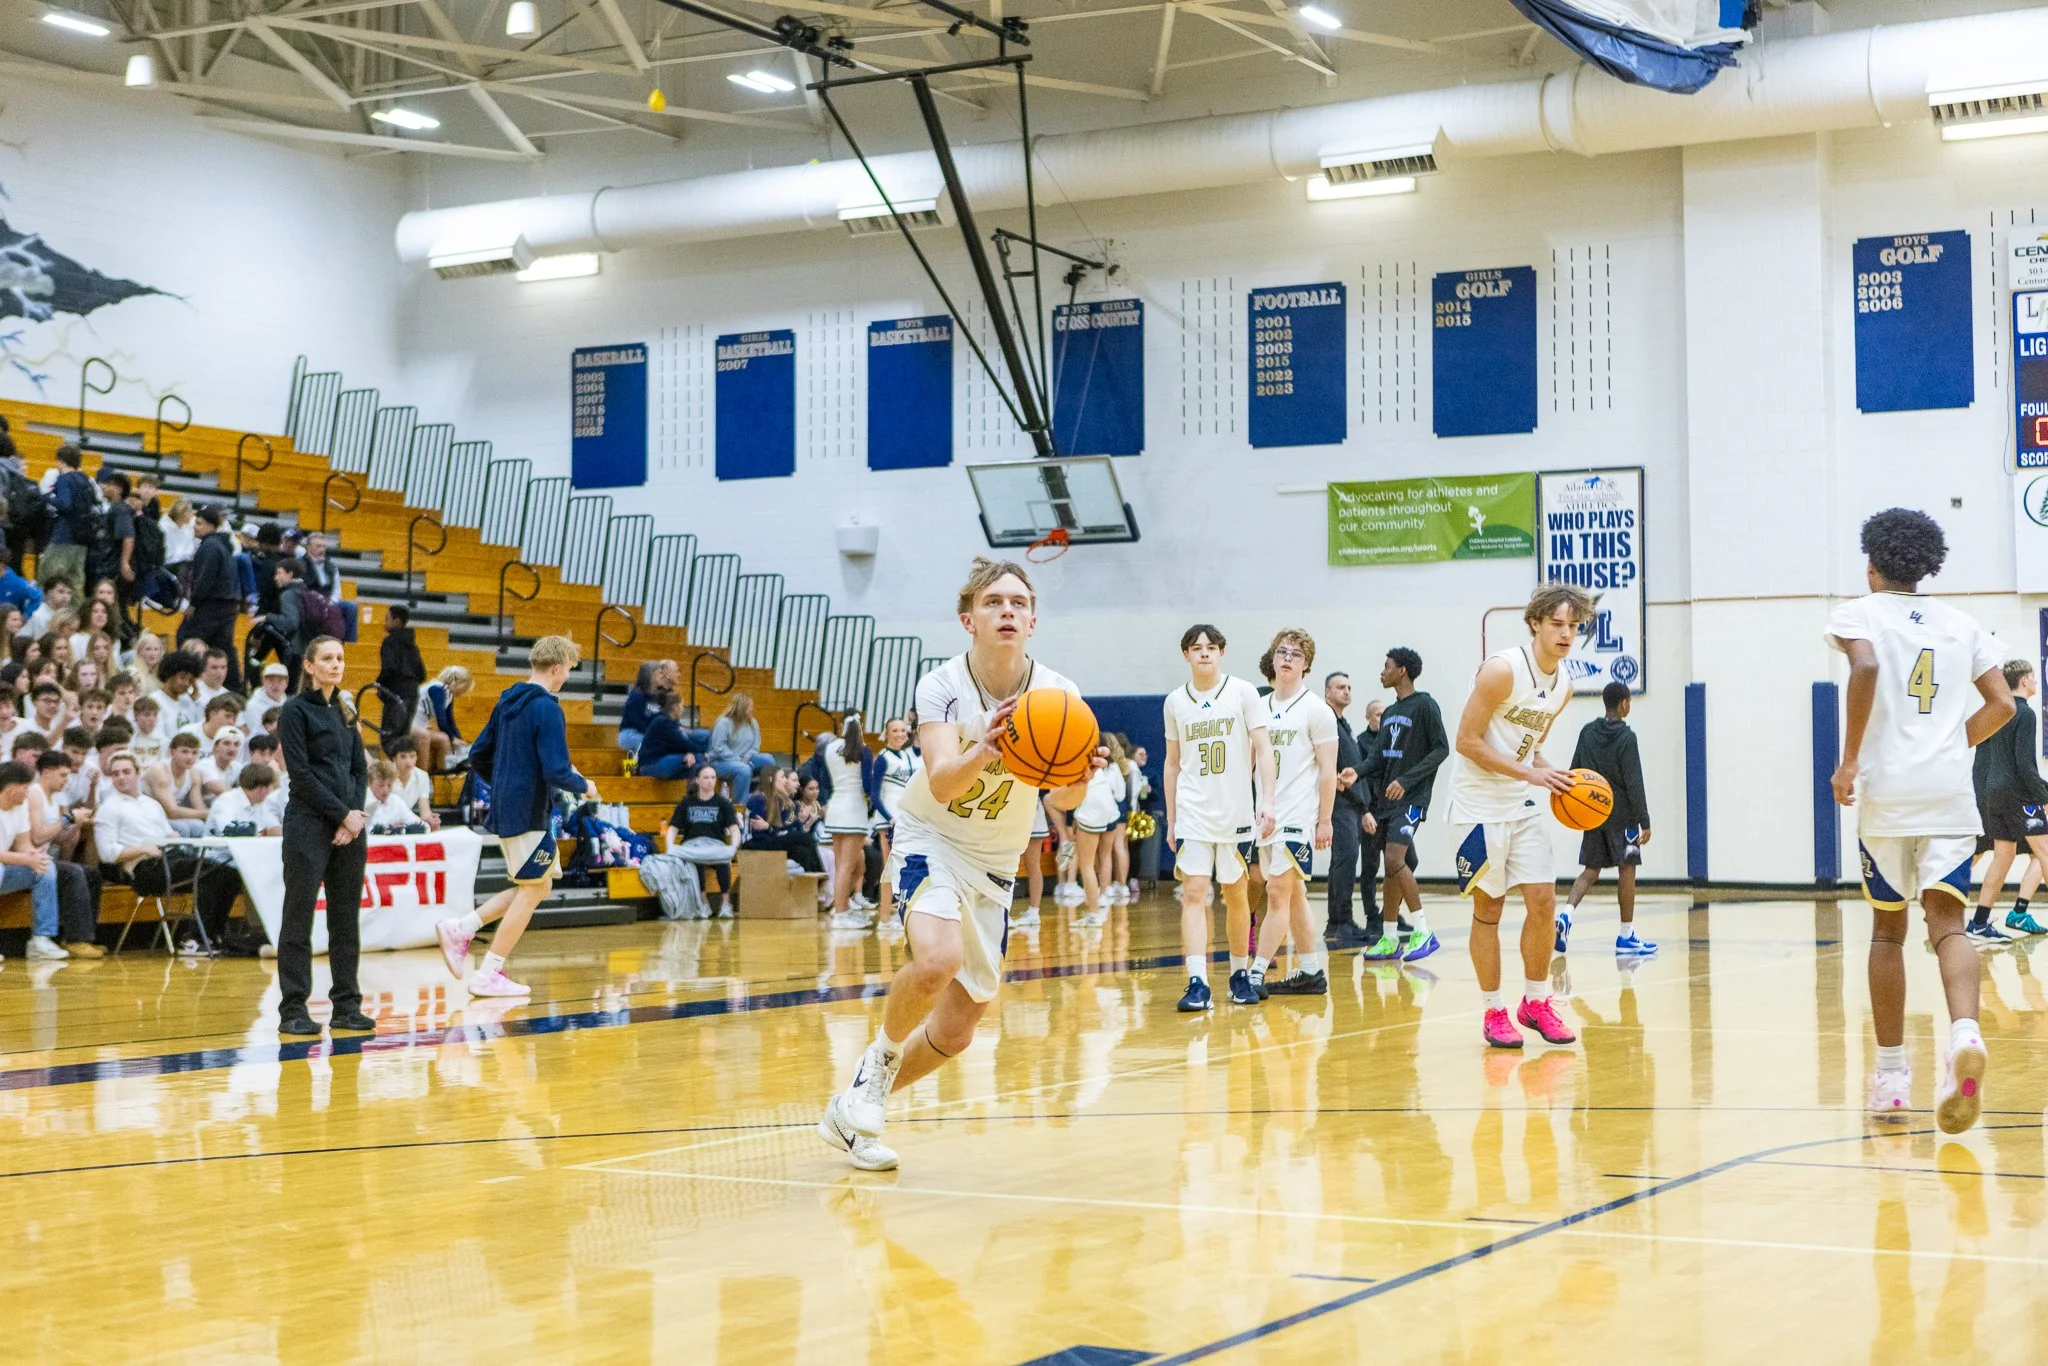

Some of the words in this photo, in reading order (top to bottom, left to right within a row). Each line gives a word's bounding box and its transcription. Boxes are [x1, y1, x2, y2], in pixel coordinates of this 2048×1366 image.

[1893, 235, 1929, 247] BOYS
[1880, 245, 1944, 266] GOLF
[1465, 270, 1502, 281] GIRLS
[1858, 270, 1903, 286] 2003
[1456, 280, 1513, 299] GOLF
[1857, 284, 1903, 299] 2004
[1102, 301, 1134, 311] GIRLS
[1253, 288, 1342, 310] FOOTBALL
[1435, 300, 1472, 314] 2014
[896, 319, 924, 328] BOYS
[1091, 310, 1140, 328] COUNTRY
[1255, 315, 1291, 329] 2001
[1435, 313, 1472, 328] 2015
[741, 332, 770, 342] GIRLS
[870, 326, 950, 347] BASKETBALL
[1256, 329, 1293, 342] 2002
[718, 340, 794, 359] BASKETBALL
[1256, 342, 1293, 356] 2003
[575, 348, 645, 368] BASEBALL
[718, 359, 748, 372] 2007
[1256, 355, 1290, 368] 2015
[1256, 369, 1293, 382] 2022
[1256, 382, 1294, 396] 2023
[1339, 488, 1404, 504] Advocating
[1407, 488, 1424, 500] for
[1426, 486, 1472, 499] athletes
[1476, 484, 1498, 496] and
[1339, 506, 1385, 519] patients
[1389, 501, 1452, 516] throughout
[1339, 522, 1358, 532] our
[1361, 518, 1426, 531] community.
[1547, 512, 1585, 531] WHO
[1588, 509, 1635, 530] PLAYS
[1551, 534, 1574, 561] IN
[1579, 531, 1631, 560] THIS
[1548, 561, 1636, 589] HOUSE?
[1908, 648, 1939, 714] 4
[1185, 717, 1235, 742] LEGACY
[1198, 741, 1226, 777] 30
[947, 778, 1014, 820] 24
